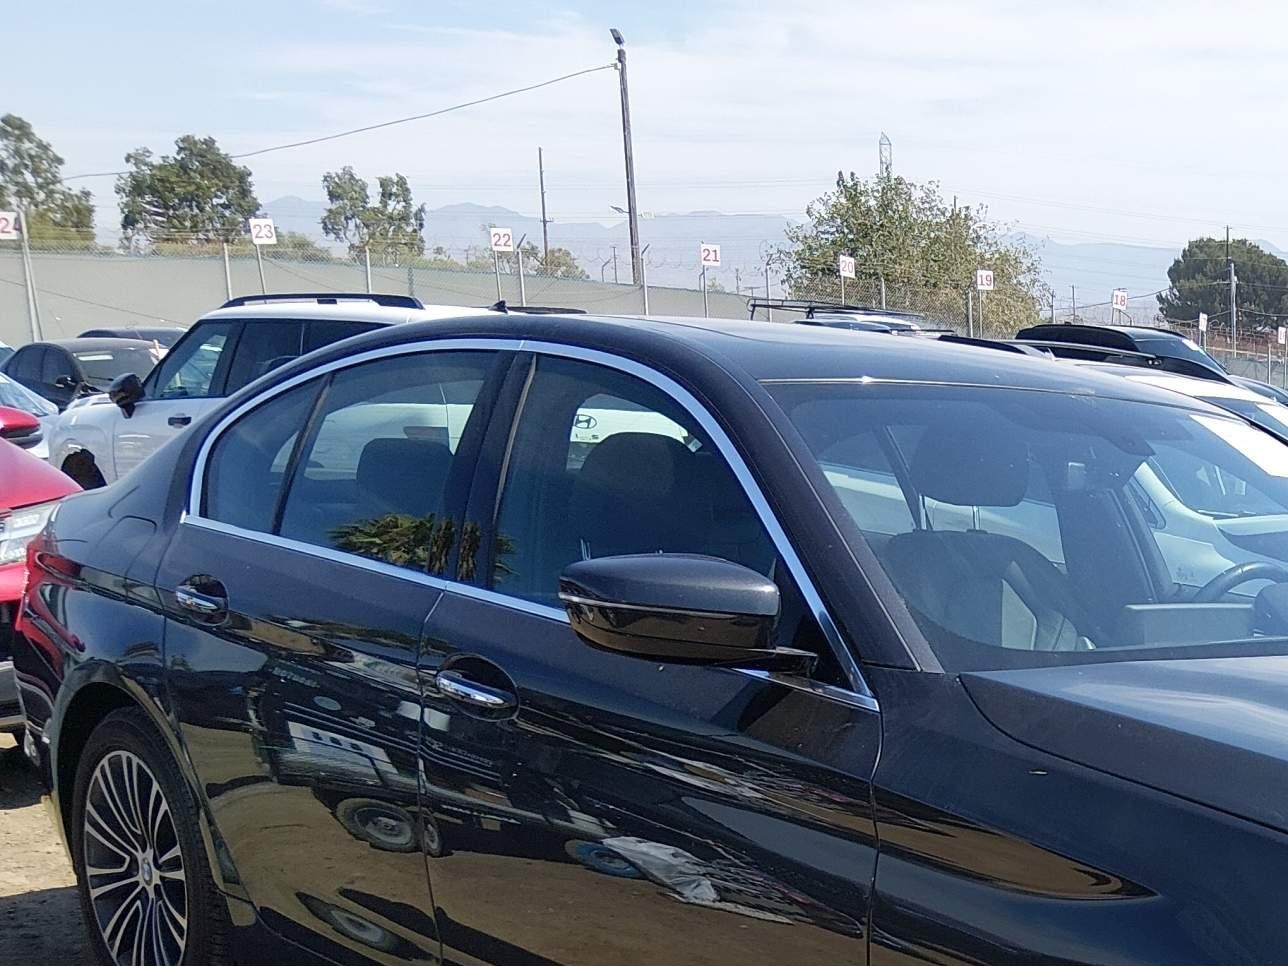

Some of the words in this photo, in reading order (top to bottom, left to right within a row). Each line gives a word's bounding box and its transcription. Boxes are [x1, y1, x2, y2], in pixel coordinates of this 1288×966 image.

[253, 224, 274, 239] 23
[492, 232, 512, 247] 22
[703, 248, 719, 262] 21
[841, 260, 854, 273] 20
[979, 274, 992, 286] 19
[1114, 294, 1126, 306] 18
